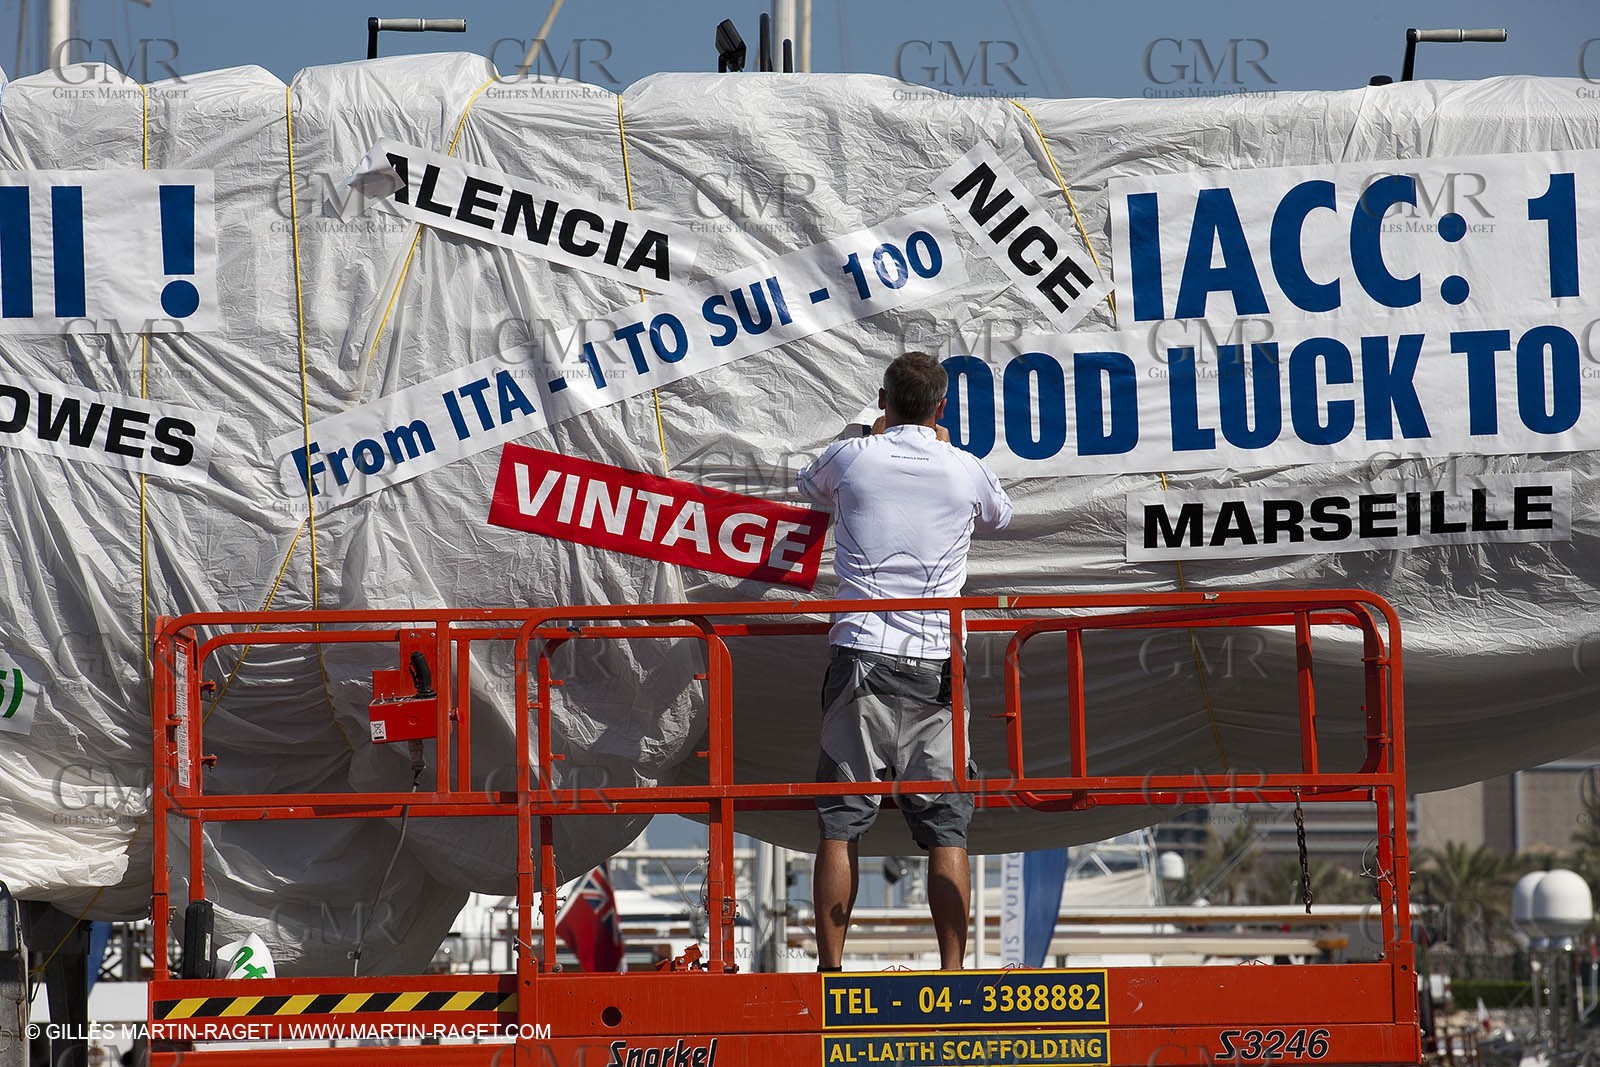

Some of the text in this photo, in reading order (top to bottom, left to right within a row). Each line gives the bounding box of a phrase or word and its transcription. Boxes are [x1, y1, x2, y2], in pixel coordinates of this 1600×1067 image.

[950, 161, 1094, 314] NICE
[1127, 172, 1580, 322] IACC: 1
[291, 419, 436, 497] From
[442, 370, 536, 441] ITA
[578, 341, 607, 390] 1
[614, 312, 688, 376] TO
[701, 275, 793, 348] SUI
[842, 230, 943, 300] 100
[936, 352, 1139, 461] OOD
[1167, 333, 1432, 453] LUCK
[1450, 325, 1581, 436] TO
[514, 462, 812, 574] VINTAGE
[1143, 485, 1554, 550] MARSEILLE
[829, 988, 879, 1015] TEL
[918, 986, 953, 1014] 04
[982, 984, 1101, 1012] 3388882
[606, 1037, 718, 1067] Snorkel
[829, 1041, 935, 1063] AL-LAITH
[942, 1038, 1102, 1060] SCAFFOLDING
[1215, 1028, 1331, 1061] S3246
